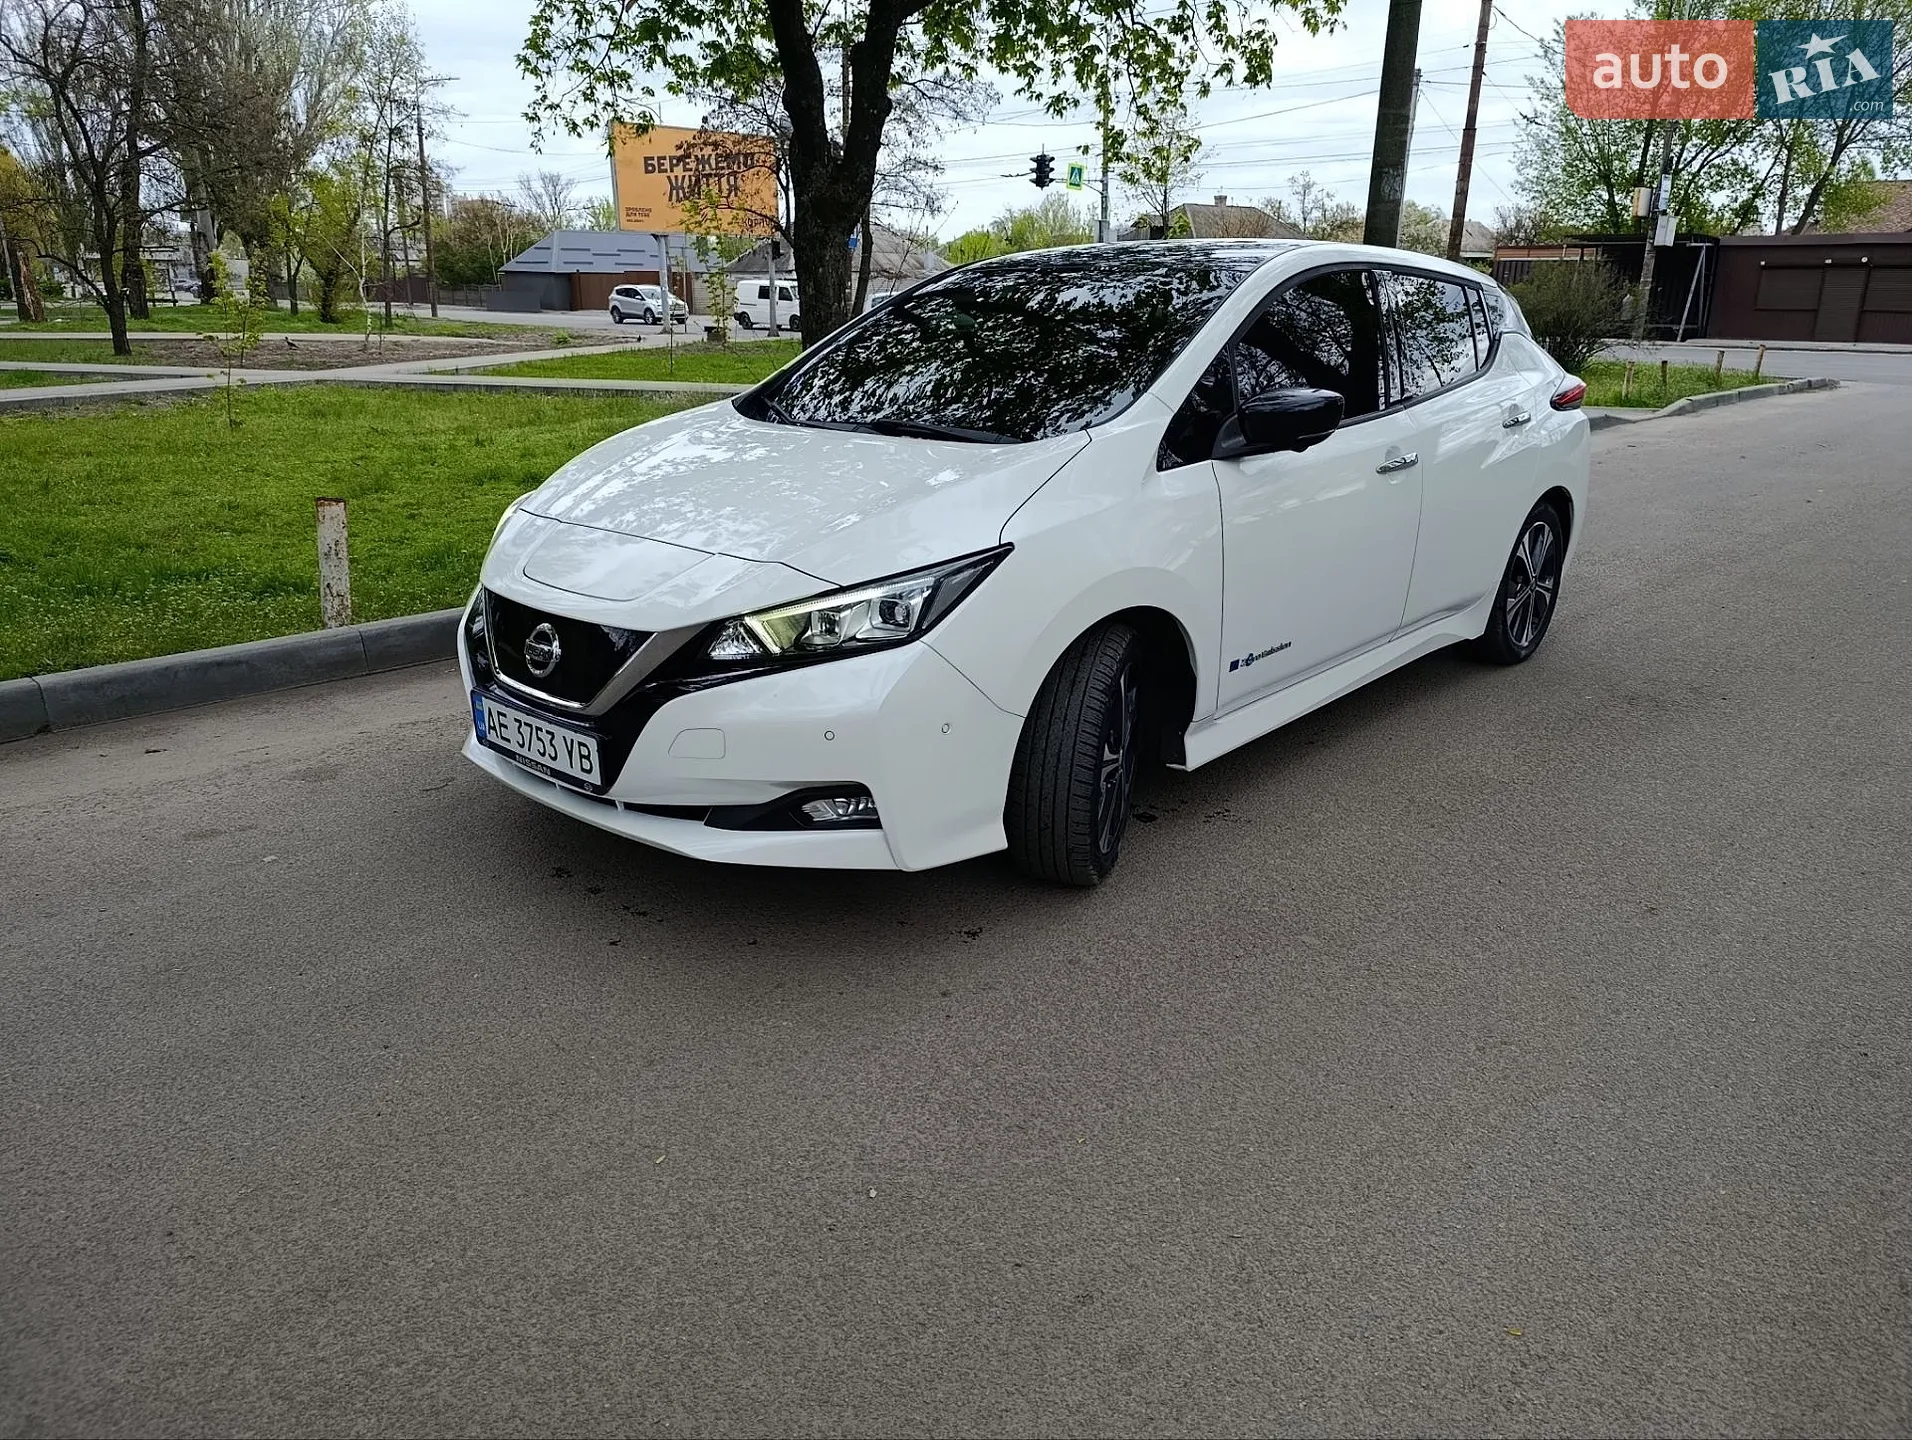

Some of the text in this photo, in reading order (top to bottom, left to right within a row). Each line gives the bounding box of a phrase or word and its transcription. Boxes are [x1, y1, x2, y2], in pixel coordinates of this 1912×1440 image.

[643, 151, 756, 174] БЕРЕЖЕМО
[667, 172, 740, 202] ЖИТТЯ
[488, 706, 593, 775] AE 3753 YB
